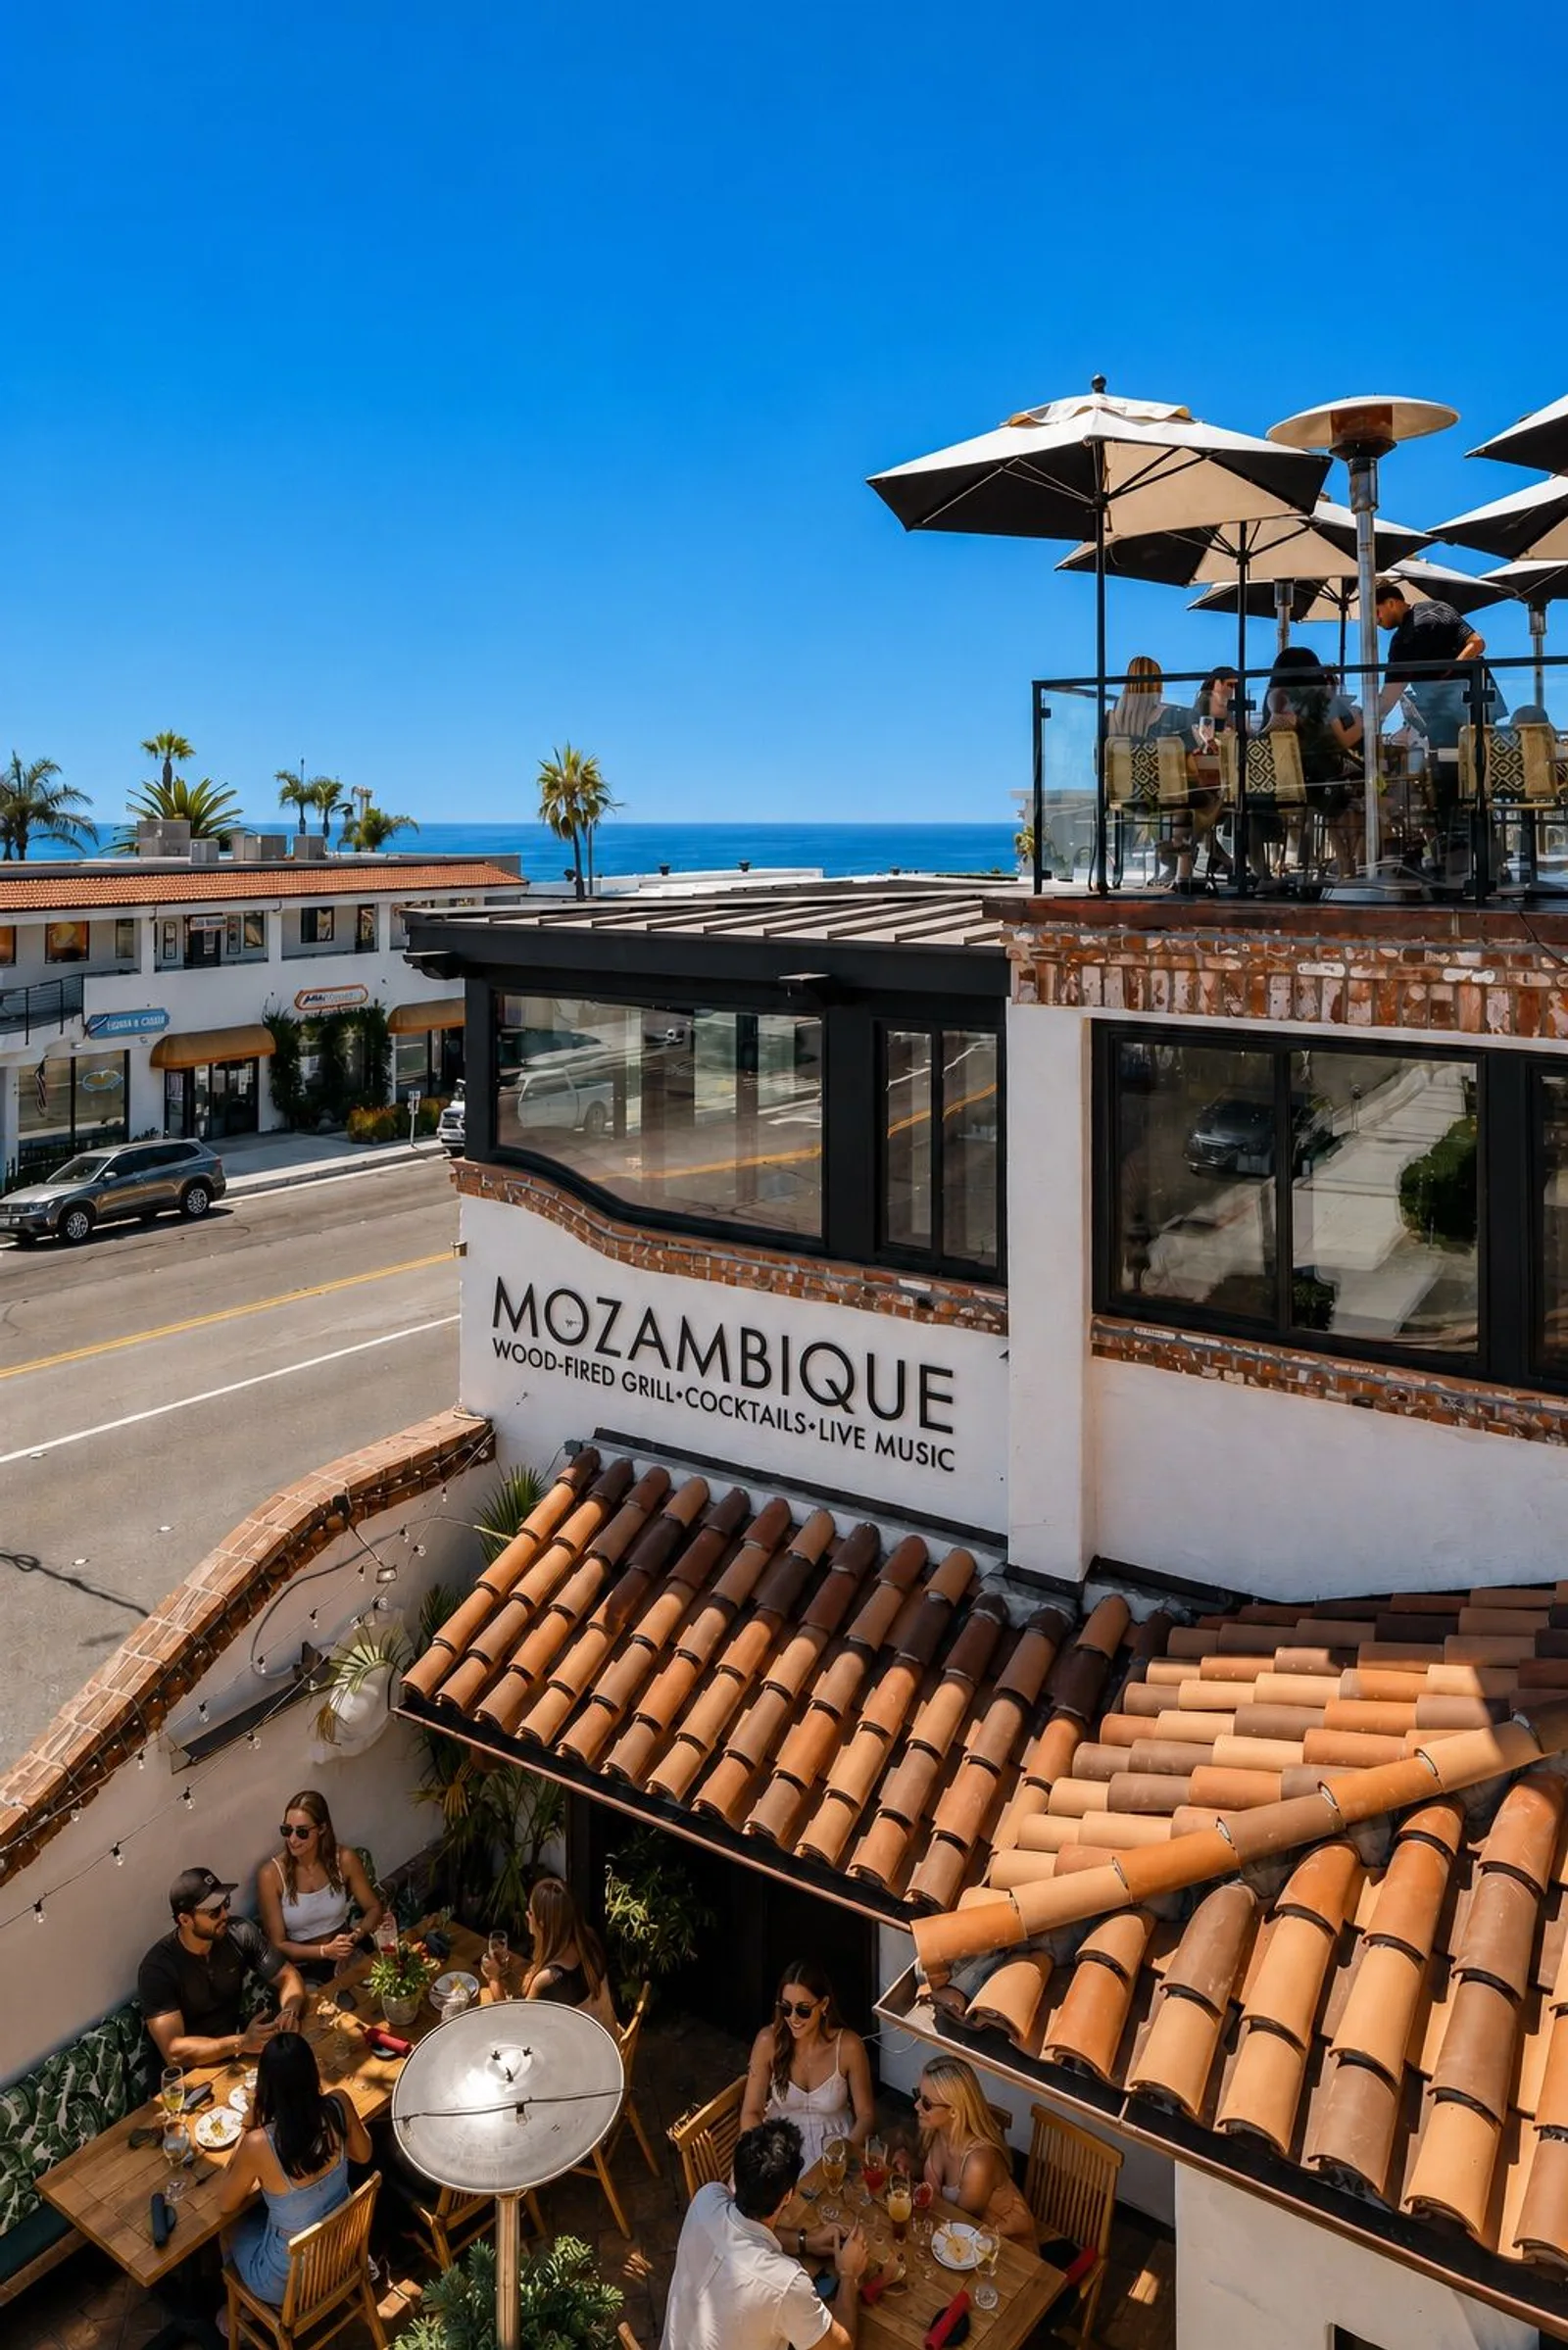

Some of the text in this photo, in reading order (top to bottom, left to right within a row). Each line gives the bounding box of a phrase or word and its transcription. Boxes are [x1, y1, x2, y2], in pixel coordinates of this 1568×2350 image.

[492, 1276, 956, 1435] MOZAMBIQUE
[492, 1337, 615, 1386] WOOD-FIRED
[874, 1431, 956, 1473] MUSIC
